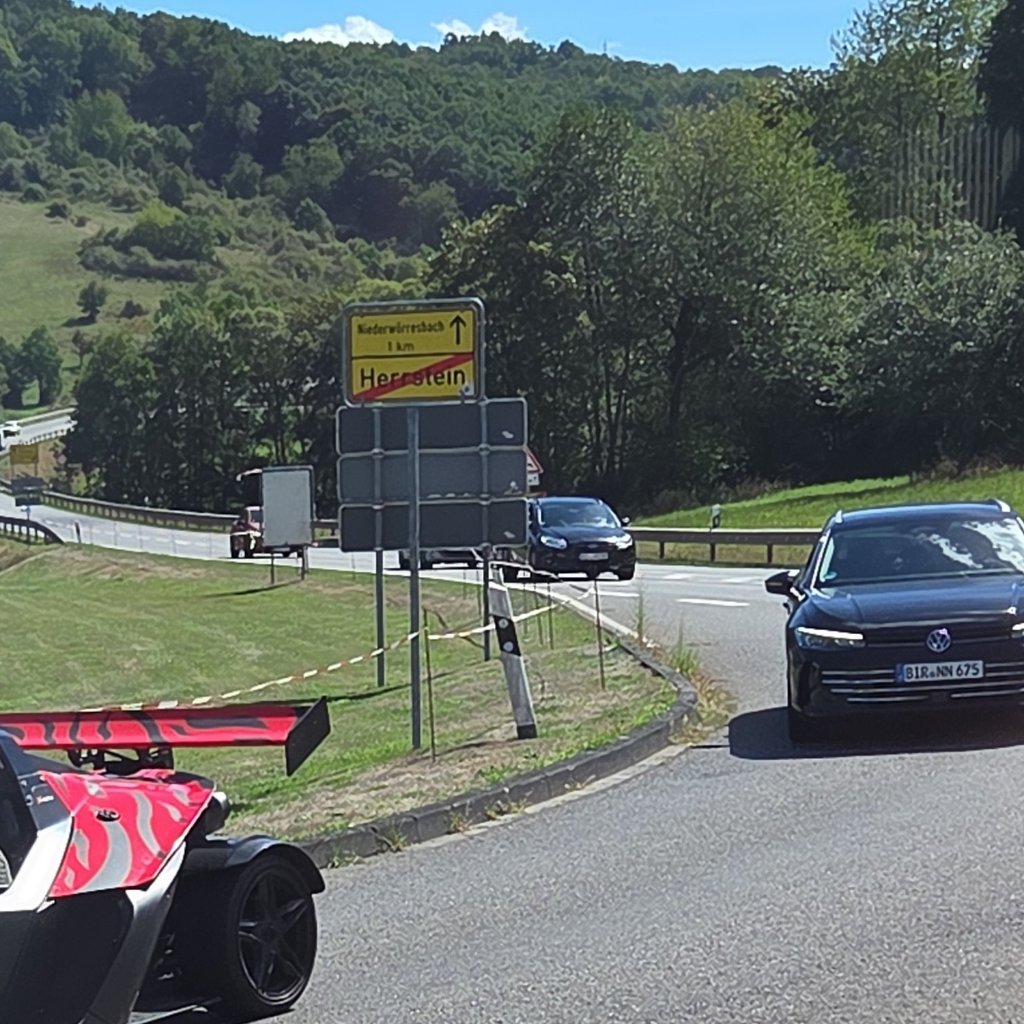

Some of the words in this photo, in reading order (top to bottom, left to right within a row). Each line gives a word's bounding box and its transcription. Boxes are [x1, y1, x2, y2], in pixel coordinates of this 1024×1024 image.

[397, 340, 415, 352] km
[360, 367, 466, 388] Herrstein
[956, 662, 980, 677] 675
